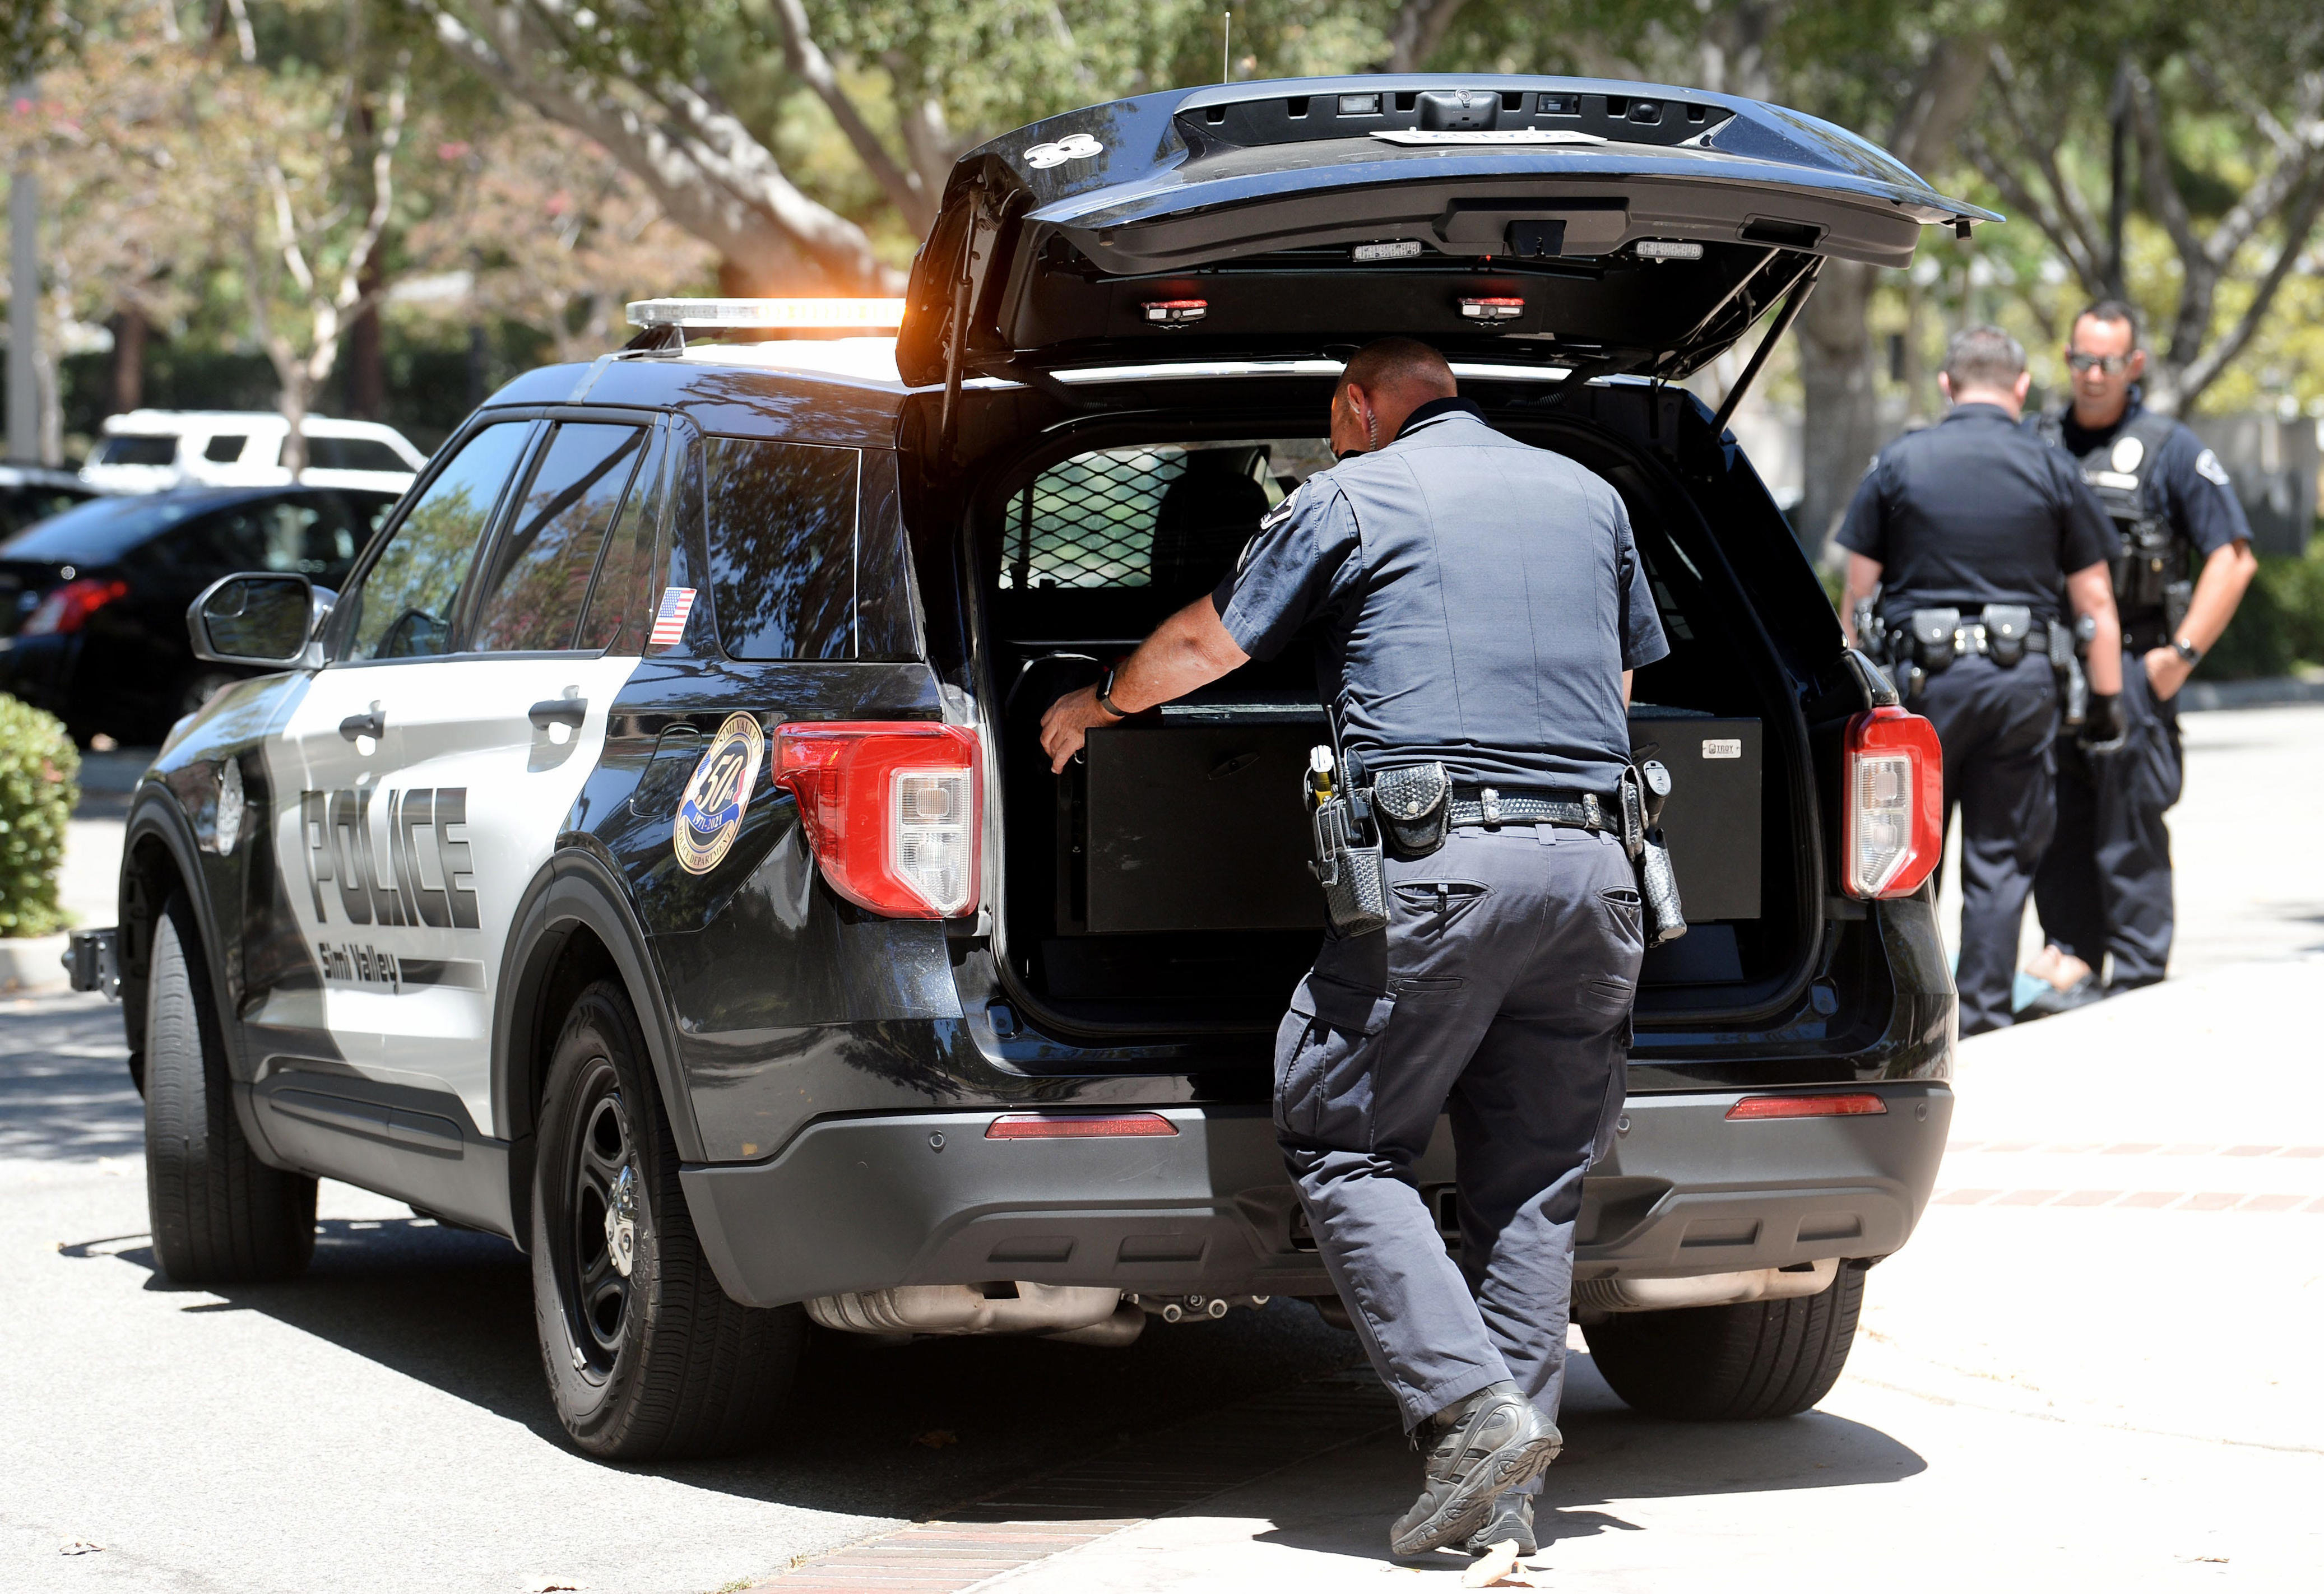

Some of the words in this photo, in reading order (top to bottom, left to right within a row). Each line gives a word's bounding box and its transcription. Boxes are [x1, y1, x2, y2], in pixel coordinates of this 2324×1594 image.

[719, 722, 735, 746] SIMI
[736, 719, 760, 749] VALLEY
[693, 812, 723, 830] 1971-2021
[301, 787, 481, 930] POLICE
[319, 943, 352, 979] Simi
[350, 944, 400, 995] Valley
